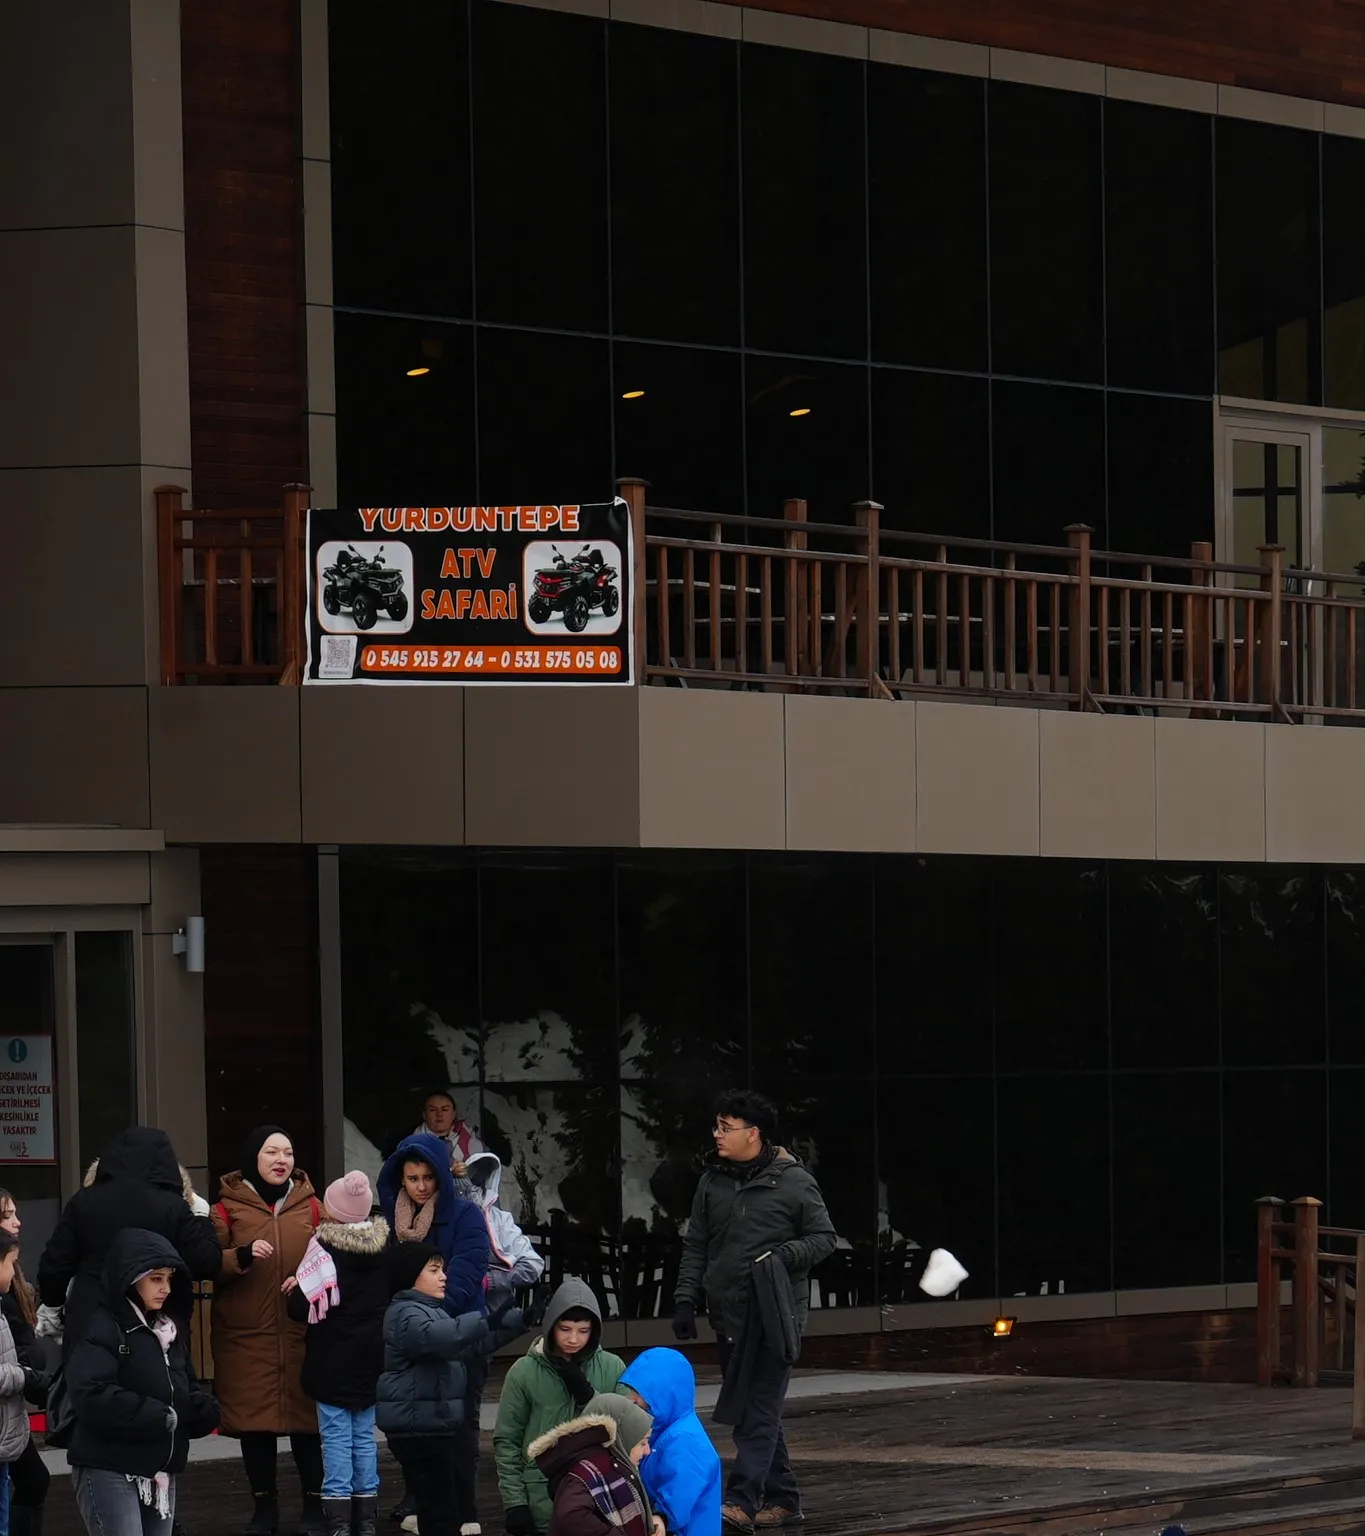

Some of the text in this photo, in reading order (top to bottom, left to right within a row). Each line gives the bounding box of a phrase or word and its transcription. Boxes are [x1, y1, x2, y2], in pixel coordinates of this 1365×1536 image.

[358, 505, 580, 532] YURDUNTEPE
[440, 548, 496, 578] ATV
[421, 583, 518, 620] SAFARİ
[366, 650, 376, 666] 0
[380, 650, 408, 667] 545
[413, 650, 439, 667] 915
[442, 651, 461, 667] 27
[464, 651, 484, 667] 64
[501, 651, 510, 668] 0
[514, 651, 540, 668] 531
[545, 651, 571, 668] 575
[576, 651, 595, 668] 05
[599, 651, 618, 668] 08
[17, 1086, 26, 1094] VE
[27, 1084, 51, 1096] İÇECEK
[3, 1126, 37, 1136] YASAKTIR
